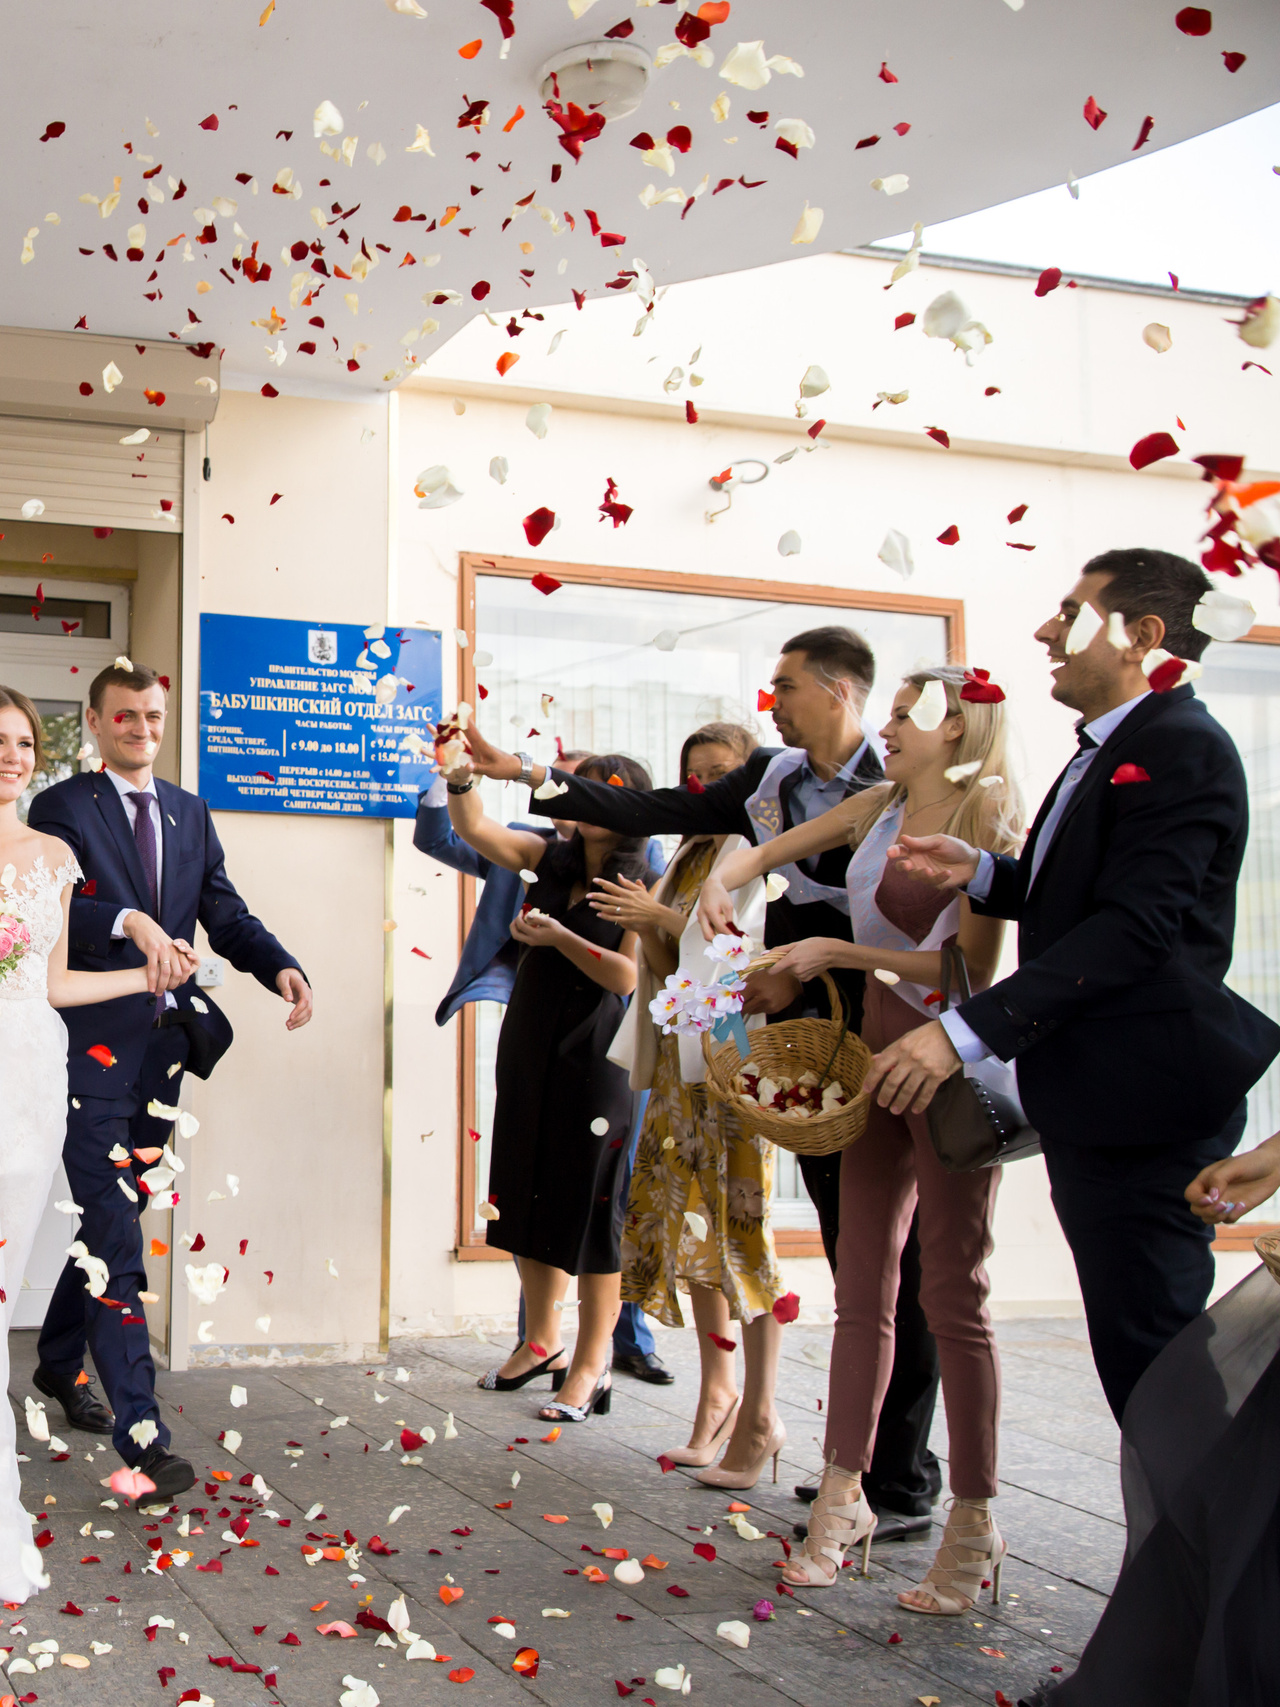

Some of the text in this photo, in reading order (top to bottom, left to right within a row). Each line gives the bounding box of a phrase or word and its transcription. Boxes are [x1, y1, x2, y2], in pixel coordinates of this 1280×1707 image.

[268, 664, 338, 678] ПРАВИТЕЛЬСТВО
[249, 677, 319, 692] УПРАВЛЕНИЕ
[321, 682, 347, 694] ЗАГС
[211, 692, 433, 722] БАБУШКИНСКИЙ ОТДЕЛ ЗАГС
[295, 719, 353, 731] ЧАСЫ РАБОТЫ:
[370, 724, 393, 734] ЧАСЫ
[298, 740, 319, 752] 9.00
[320, 744, 333, 753] до
[335, 742, 360, 754] 18.00
[377, 738, 397, 750] 9.00
[246, 747, 280, 757] СУББОТА
[378, 752, 400, 763] 15.00
[279, 766, 318, 776] ПЕРЕРЫВ
[298, 778, 359, 790] ВОСКРЕСЕНЬЕ,
[238, 786, 289, 797] ЧЕТВЕРТЫЙ
[290, 788, 325, 799] ЧЕТВЕРГ
[327, 791, 368, 801] КАЖДОГО
[369, 793, 403, 804] МЕСЯЦА
[283, 800, 364, 813] САНИТАРНЫЙ ДЕНЬ
